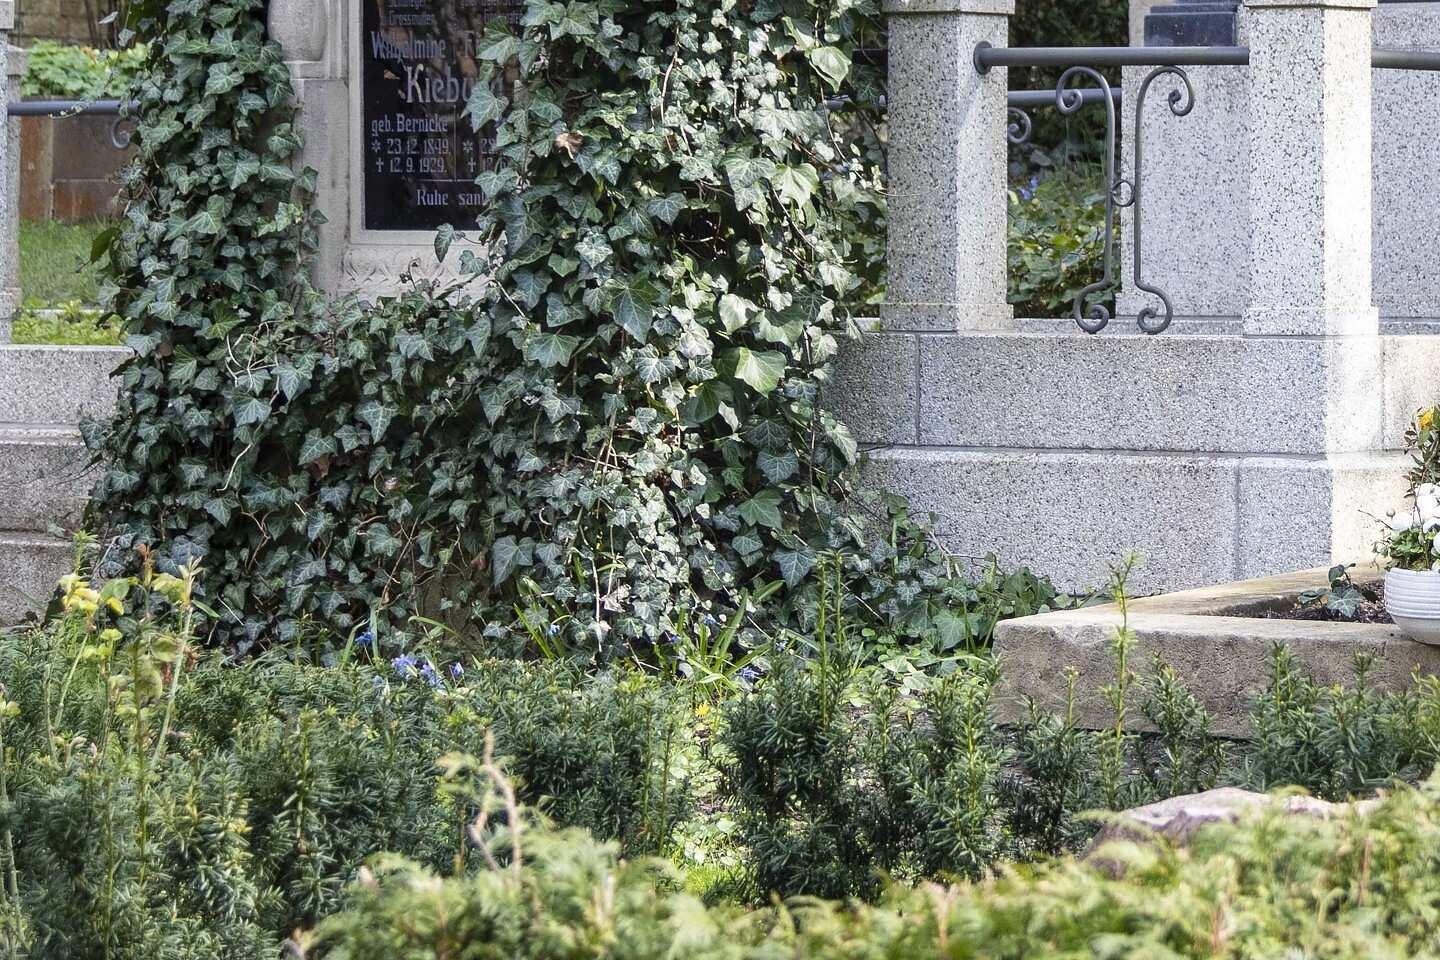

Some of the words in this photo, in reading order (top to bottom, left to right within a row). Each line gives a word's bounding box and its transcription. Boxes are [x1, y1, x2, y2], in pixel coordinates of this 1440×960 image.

[371, 113, 395, 137] geb.
[396, 112, 449, 133] Bernicke
[416, 189, 449, 206] Ruhe
